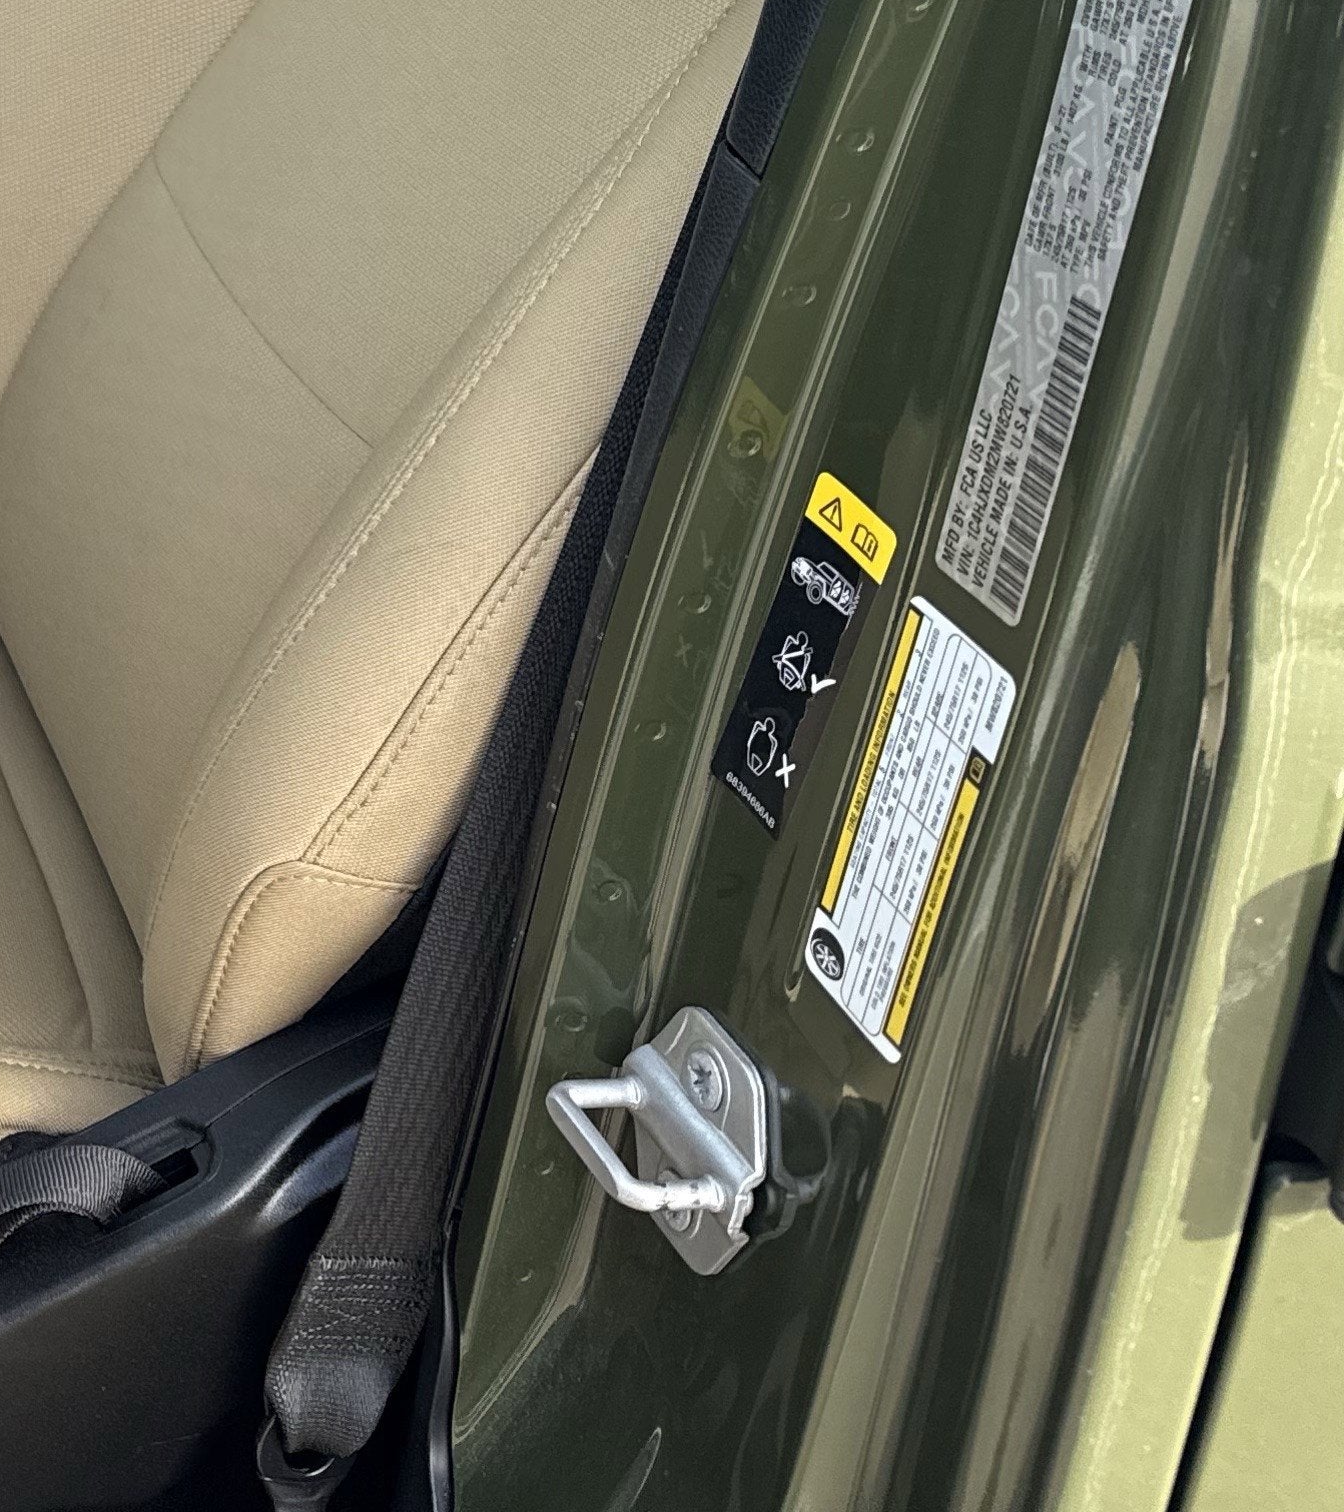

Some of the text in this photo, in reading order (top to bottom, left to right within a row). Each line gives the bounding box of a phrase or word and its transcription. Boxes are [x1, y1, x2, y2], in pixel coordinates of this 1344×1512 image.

[941, 407, 992, 565] MFD BY: FCA US LLC
[956, 371, 1021, 577] VIN: 1C4HJXDM2MW820721
[971, 398, 1032, 590] VEHICLE MADE IN: U.S.A.
[846, 811, 857, 834] TIRE
[853, 790, 863, 811] AND
[859, 750, 876, 792] LOADING
[871, 689, 895, 752] INFORMATION
[984, 675, 1007, 732] MW820721
